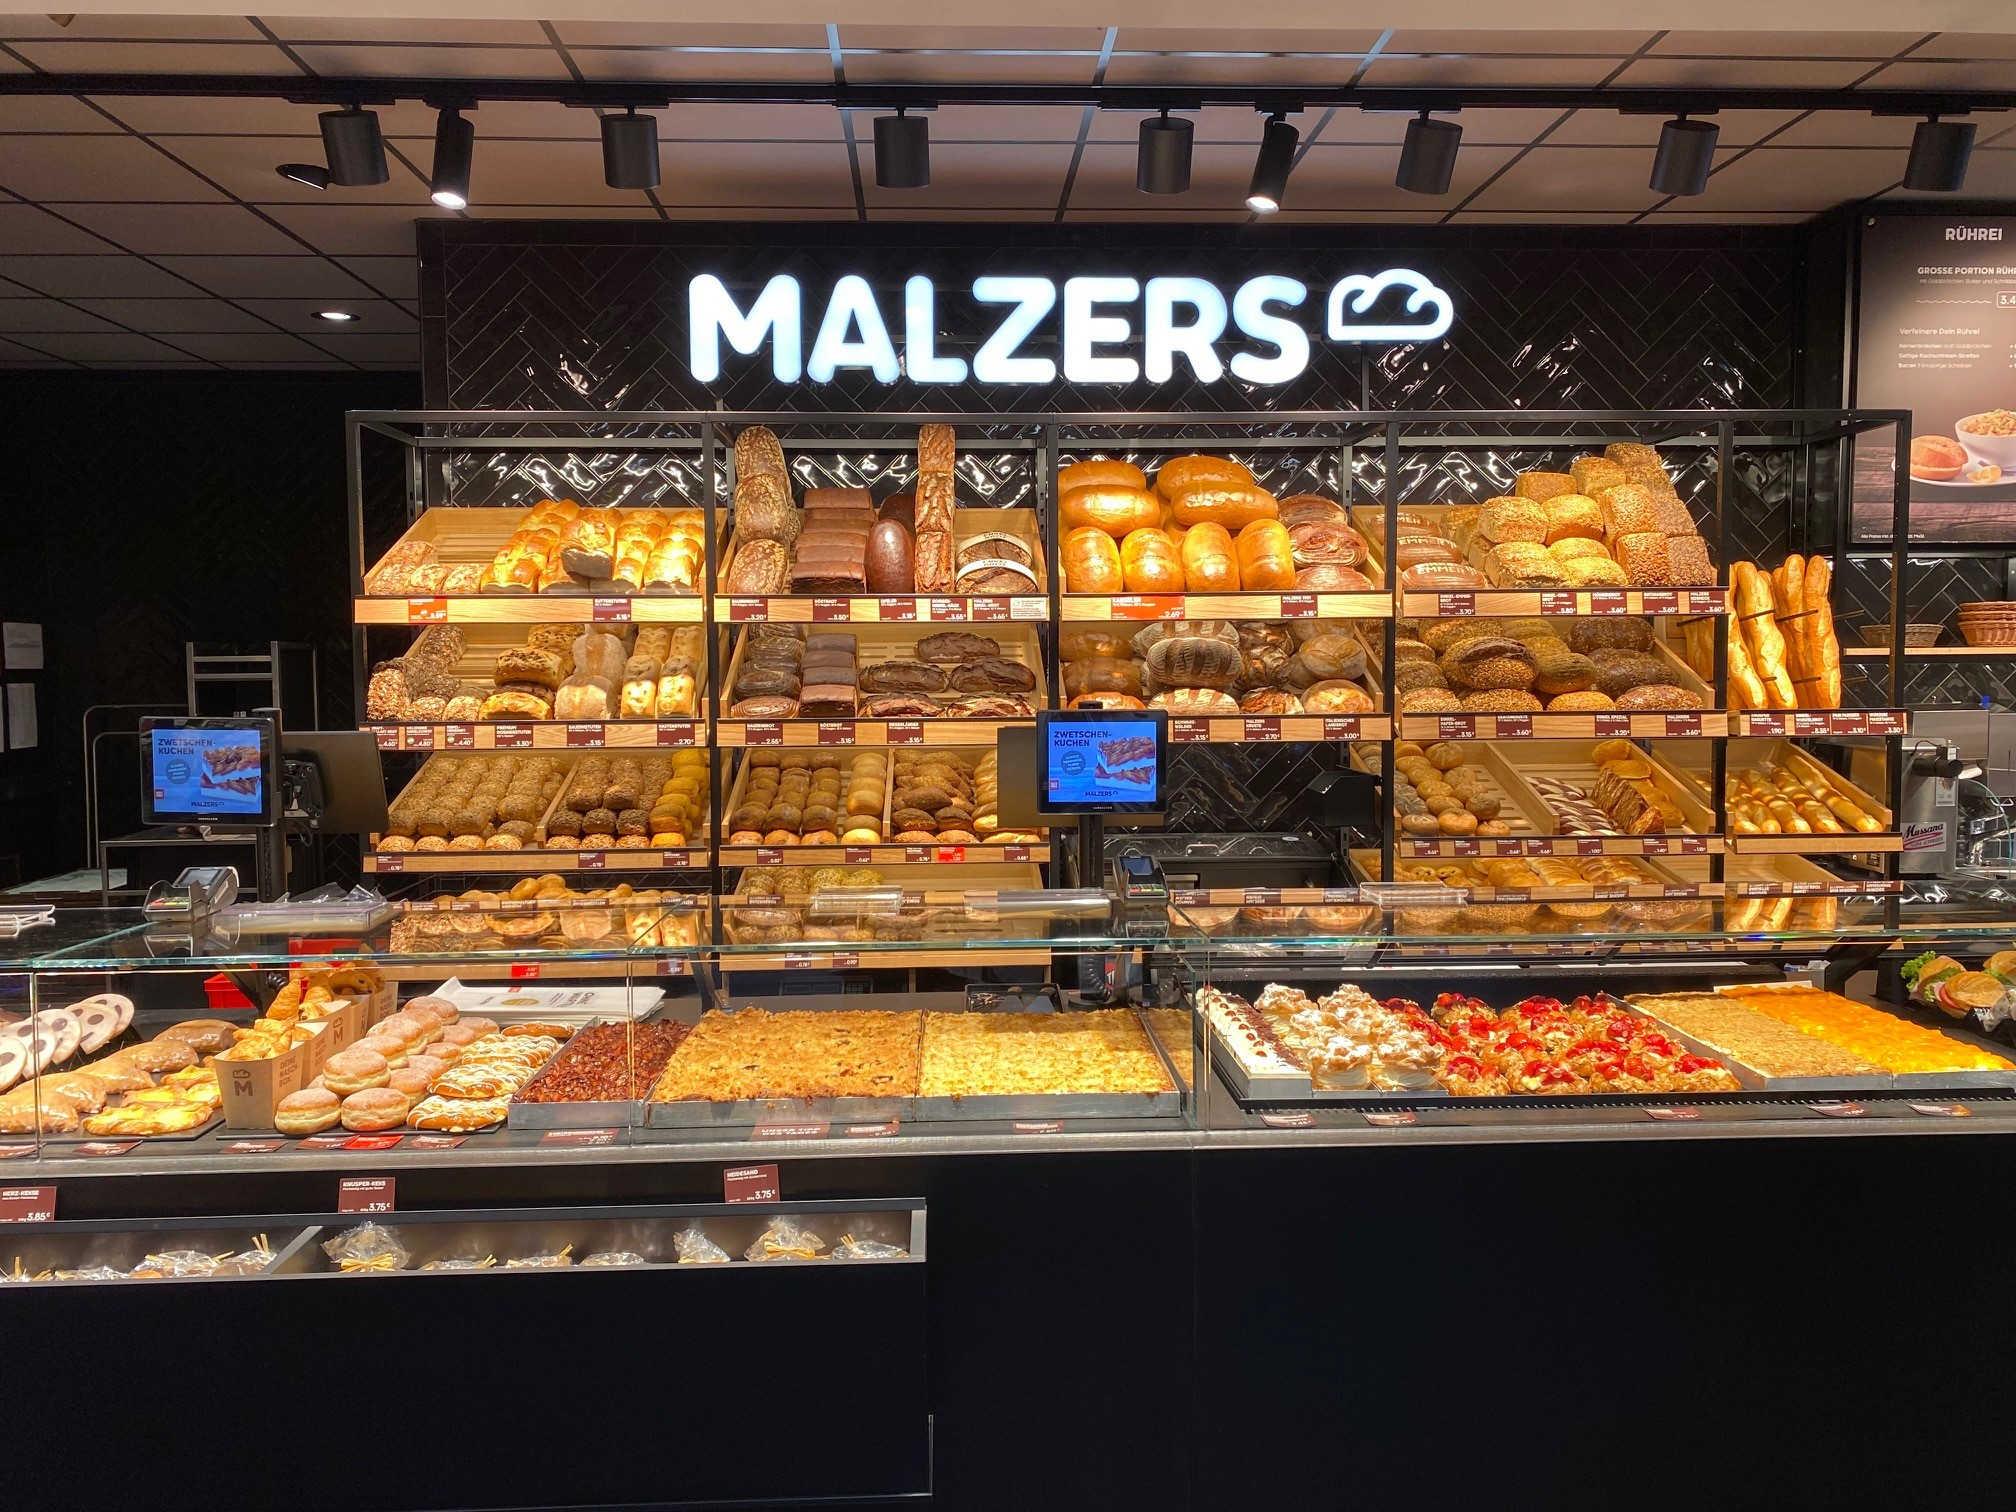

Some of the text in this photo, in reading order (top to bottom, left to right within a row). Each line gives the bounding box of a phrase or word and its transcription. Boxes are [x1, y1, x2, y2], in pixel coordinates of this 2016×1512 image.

[1945, 225, 2003, 241] RÜHREI
[1917, 266, 1954, 275] GROSSE
[1954, 266, 1995, 275] PORTION
[687, 272, 1312, 387] MALZERS
[1053, 730, 1112, 738] ZWETSCHEN-
[1053, 739, 1090, 747] KUCHEN
[158, 747, 194, 755] KUCHEN
[233, 1080, 254, 1097] M
